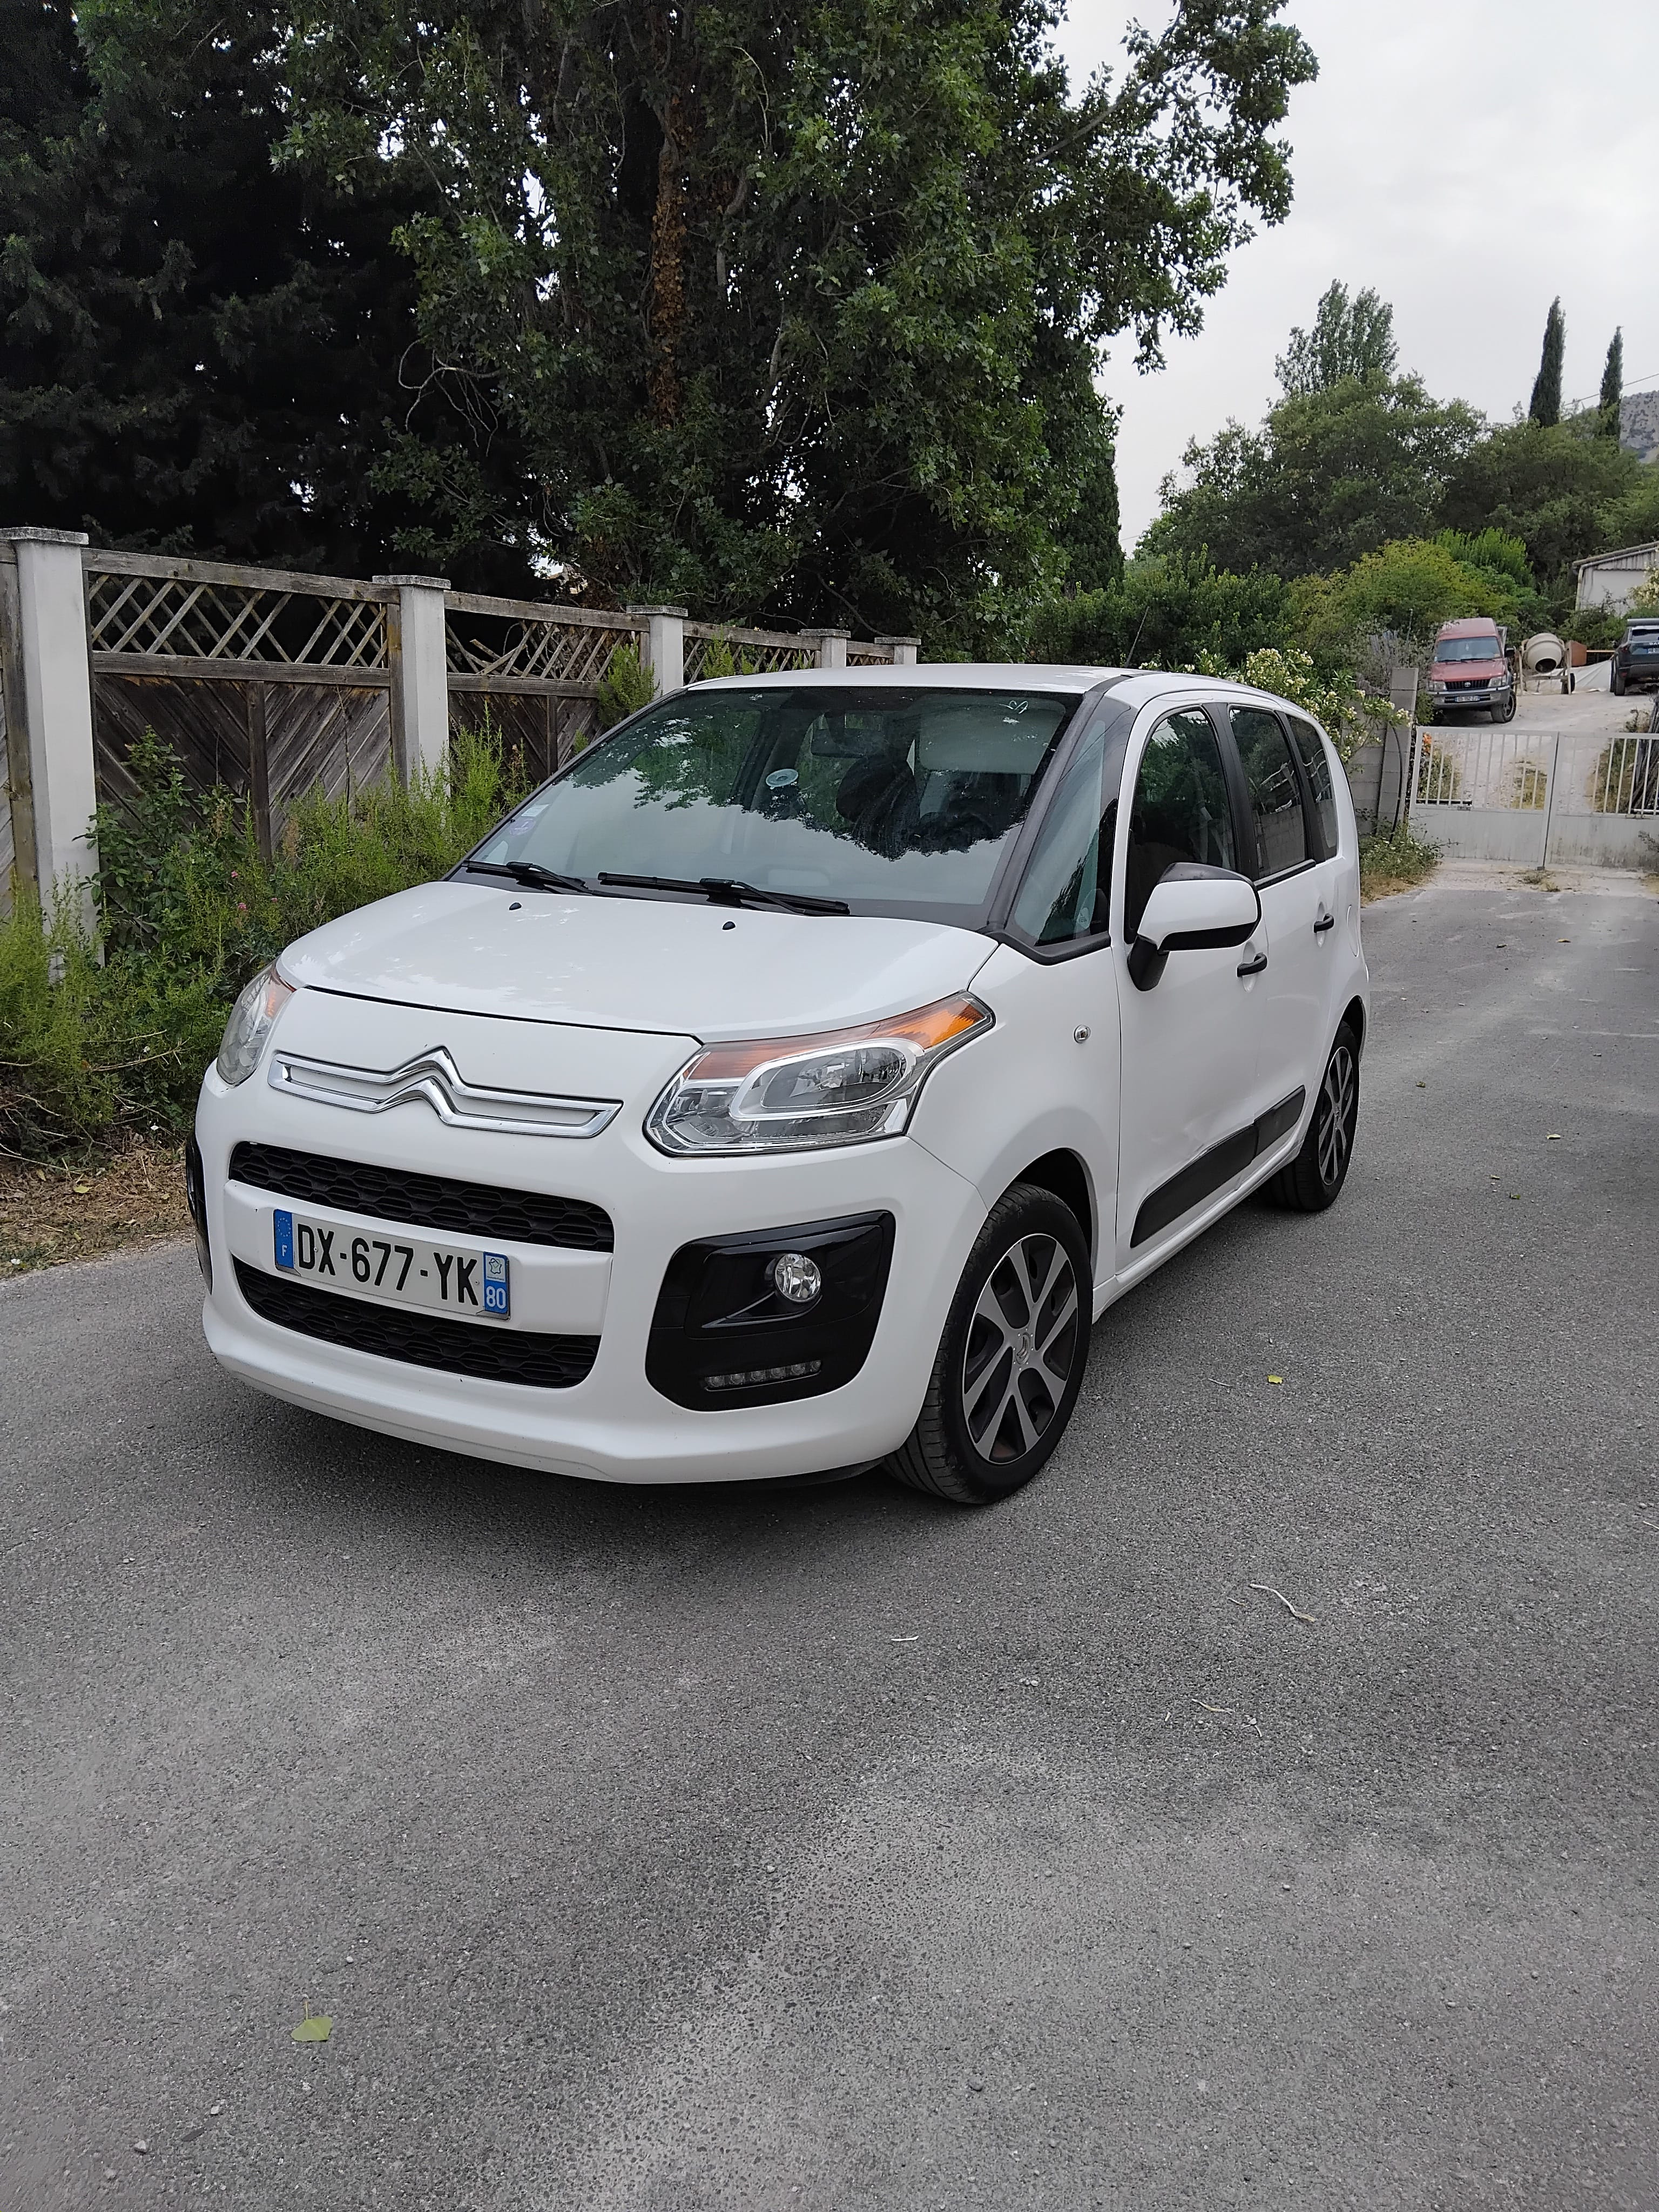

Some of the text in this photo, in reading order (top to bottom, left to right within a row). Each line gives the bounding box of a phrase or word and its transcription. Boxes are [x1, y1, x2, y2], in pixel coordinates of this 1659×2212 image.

[282, 1245, 287, 1257] F
[298, 1223, 478, 1306] DX-677-YK
[487, 1286, 506, 1309] 80
